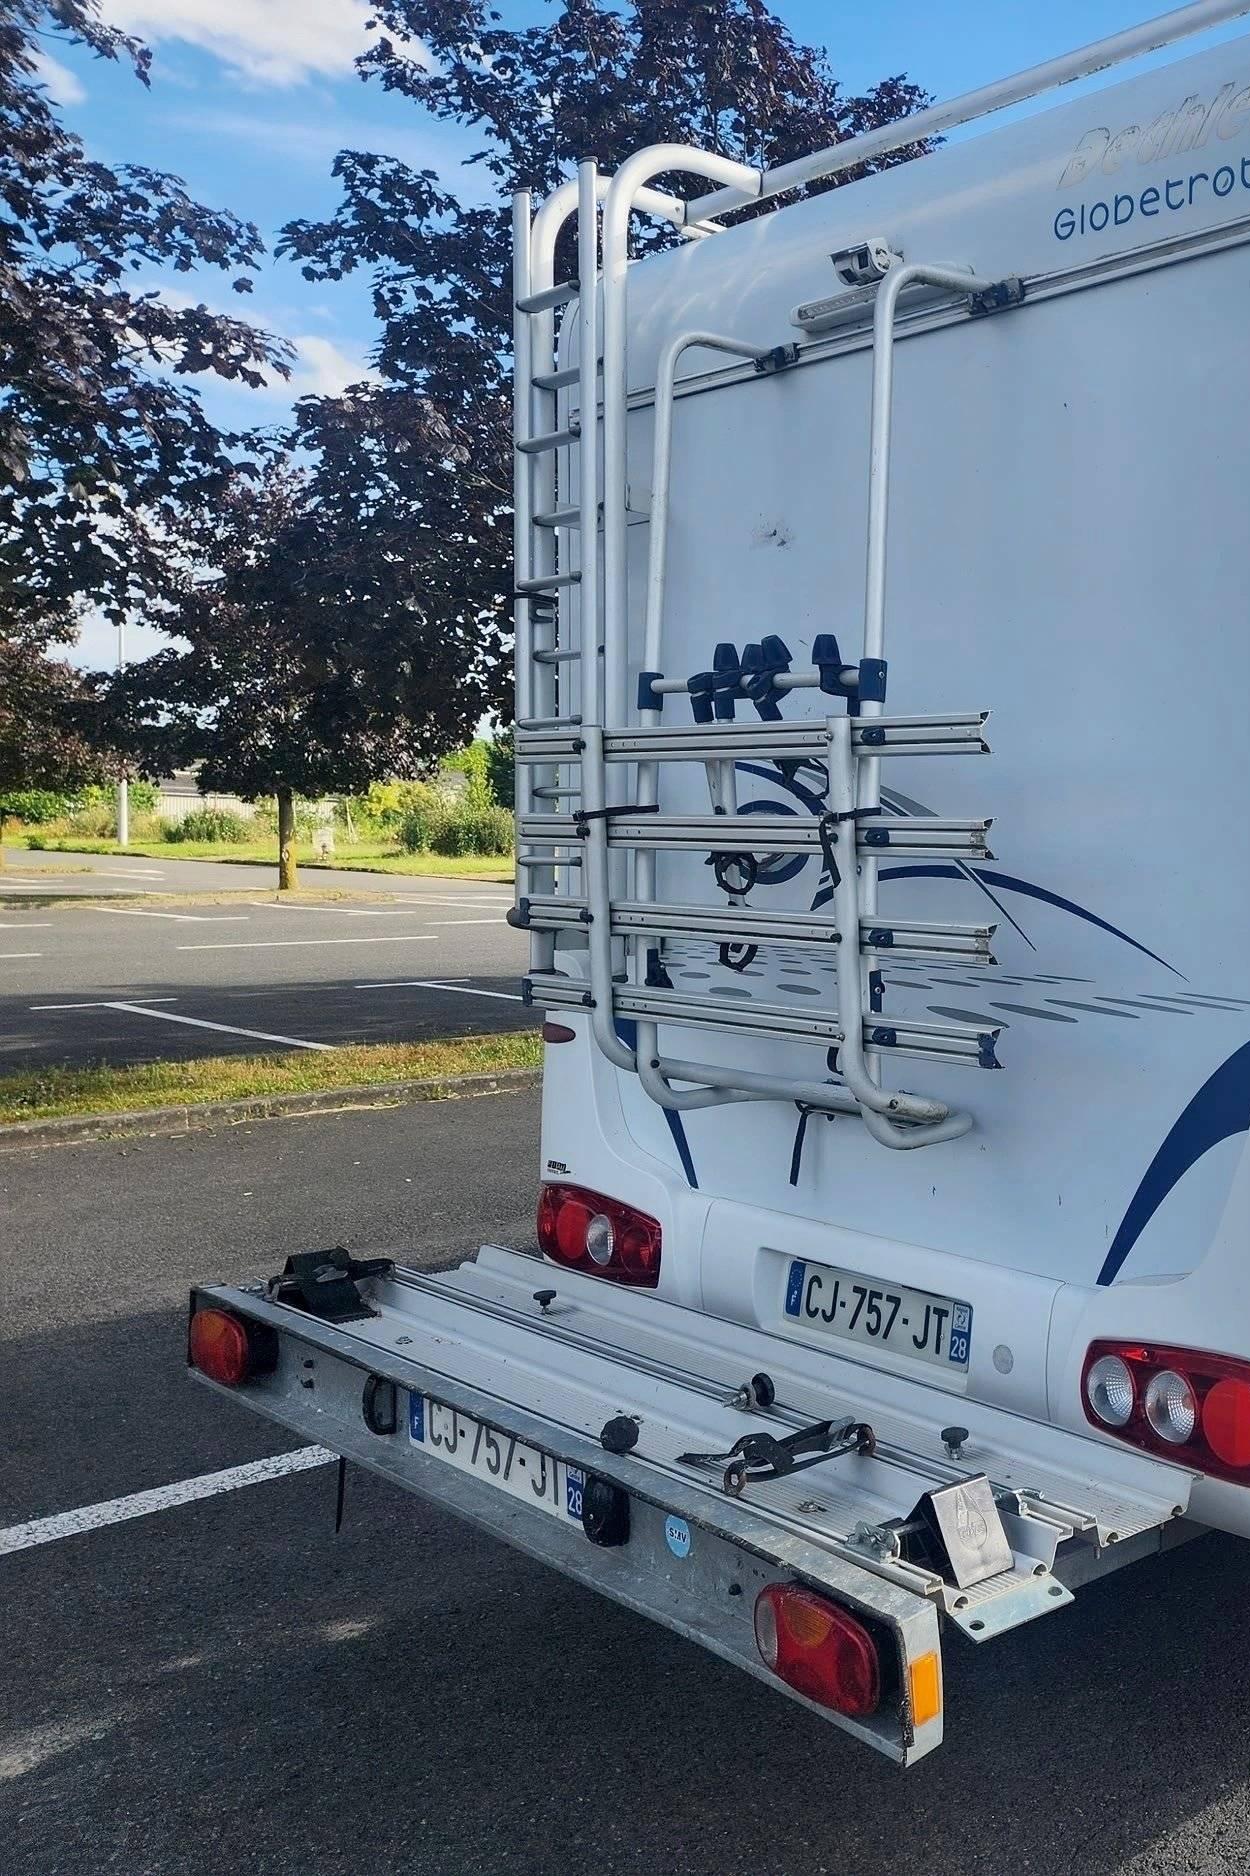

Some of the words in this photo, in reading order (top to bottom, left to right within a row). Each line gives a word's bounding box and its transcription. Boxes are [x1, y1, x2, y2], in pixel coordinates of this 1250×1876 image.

[805, 1274, 949, 1355] CJ-757-JT
[950, 1335, 967, 1360] 28
[568, 1486, 583, 1516] 28
